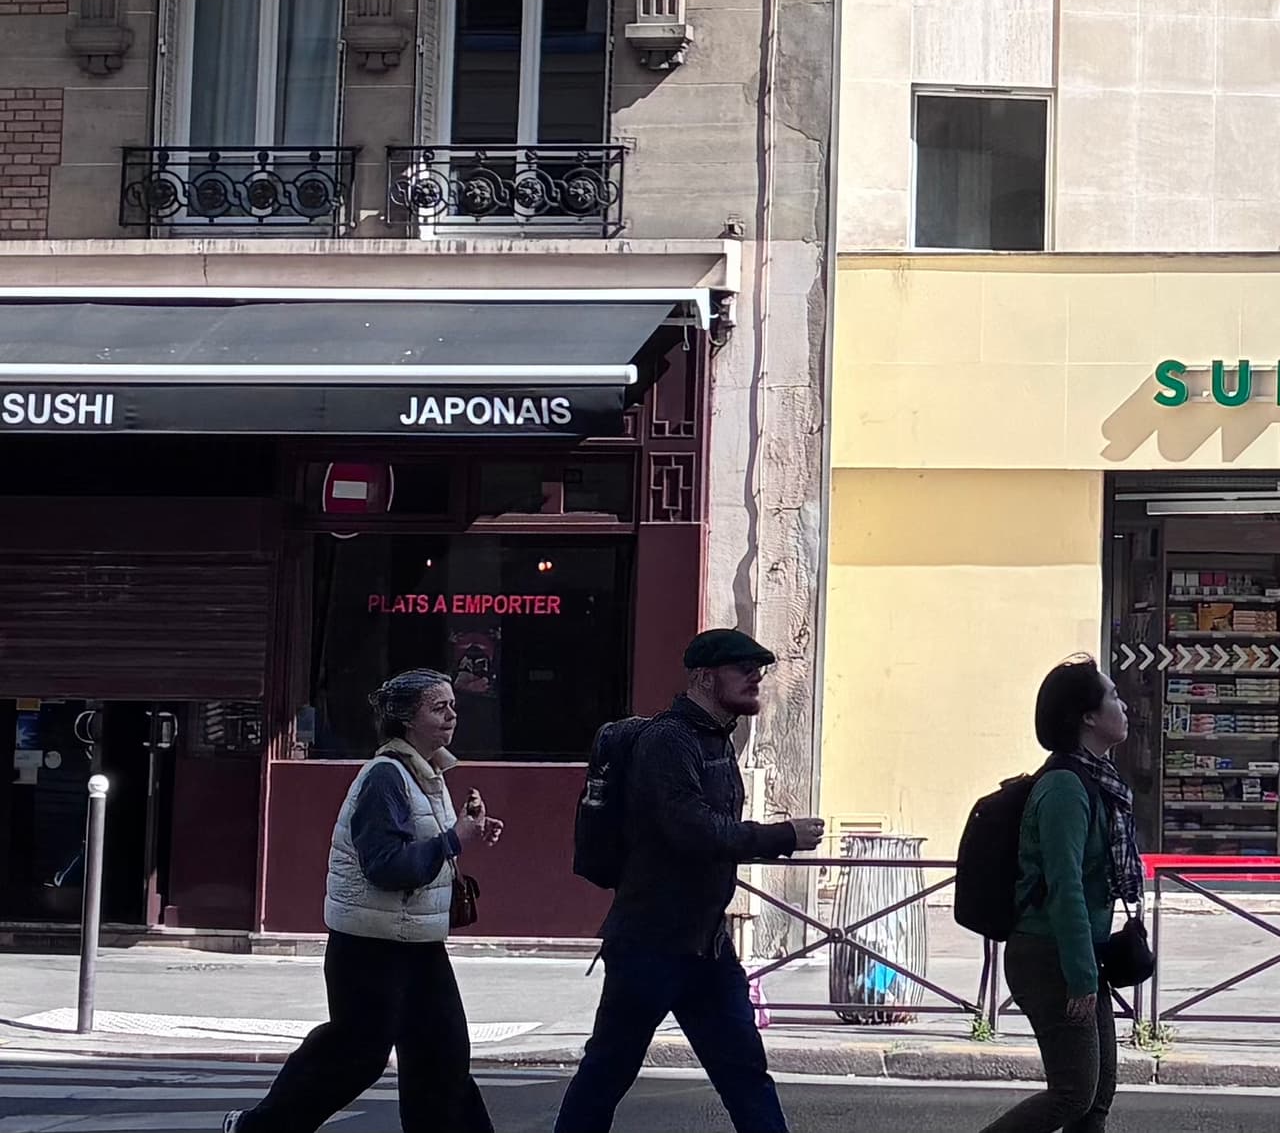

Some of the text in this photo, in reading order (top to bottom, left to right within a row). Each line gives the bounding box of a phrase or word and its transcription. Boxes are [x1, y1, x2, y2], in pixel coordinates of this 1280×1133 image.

[2, 393, 114, 424] SUSHI
[400, 397, 572, 425] JAPONAIS
[368, 594, 561, 614] PLATS A EMPORTER
